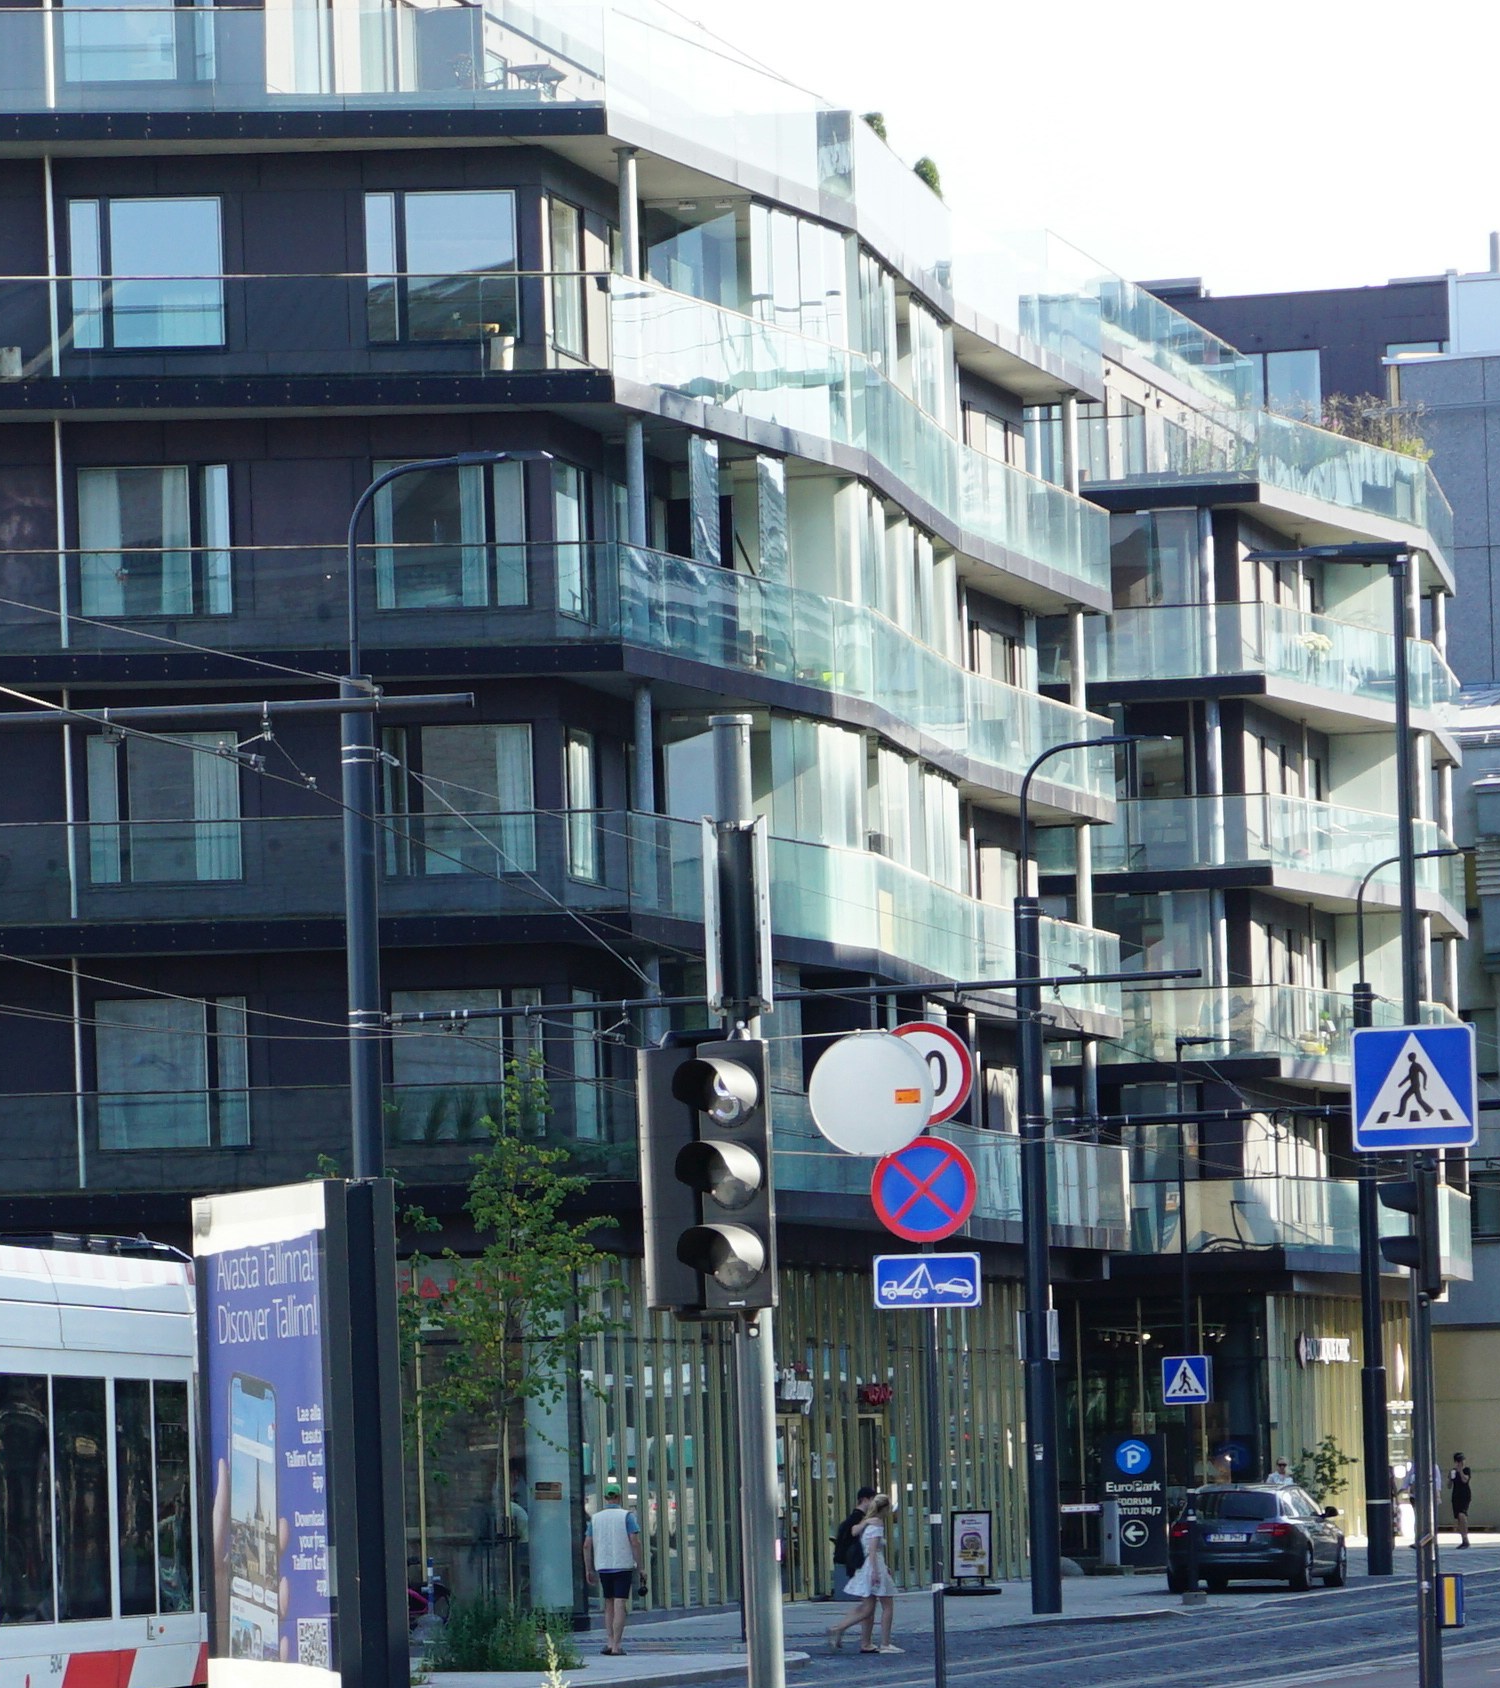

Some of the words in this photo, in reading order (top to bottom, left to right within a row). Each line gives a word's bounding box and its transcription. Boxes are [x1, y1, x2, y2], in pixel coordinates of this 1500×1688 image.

[216, 1251, 260, 1292] Avasta
[261, 1240, 315, 1286] Tallinna!
[217, 1301, 271, 1344] Discover
[272, 1294, 318, 1339] Tallinn!
[1105, 1480, 1161, 1492] EuroPark
[294, 1511, 325, 1528] Download
[1140, 1506, 1162, 1516] 24/7
